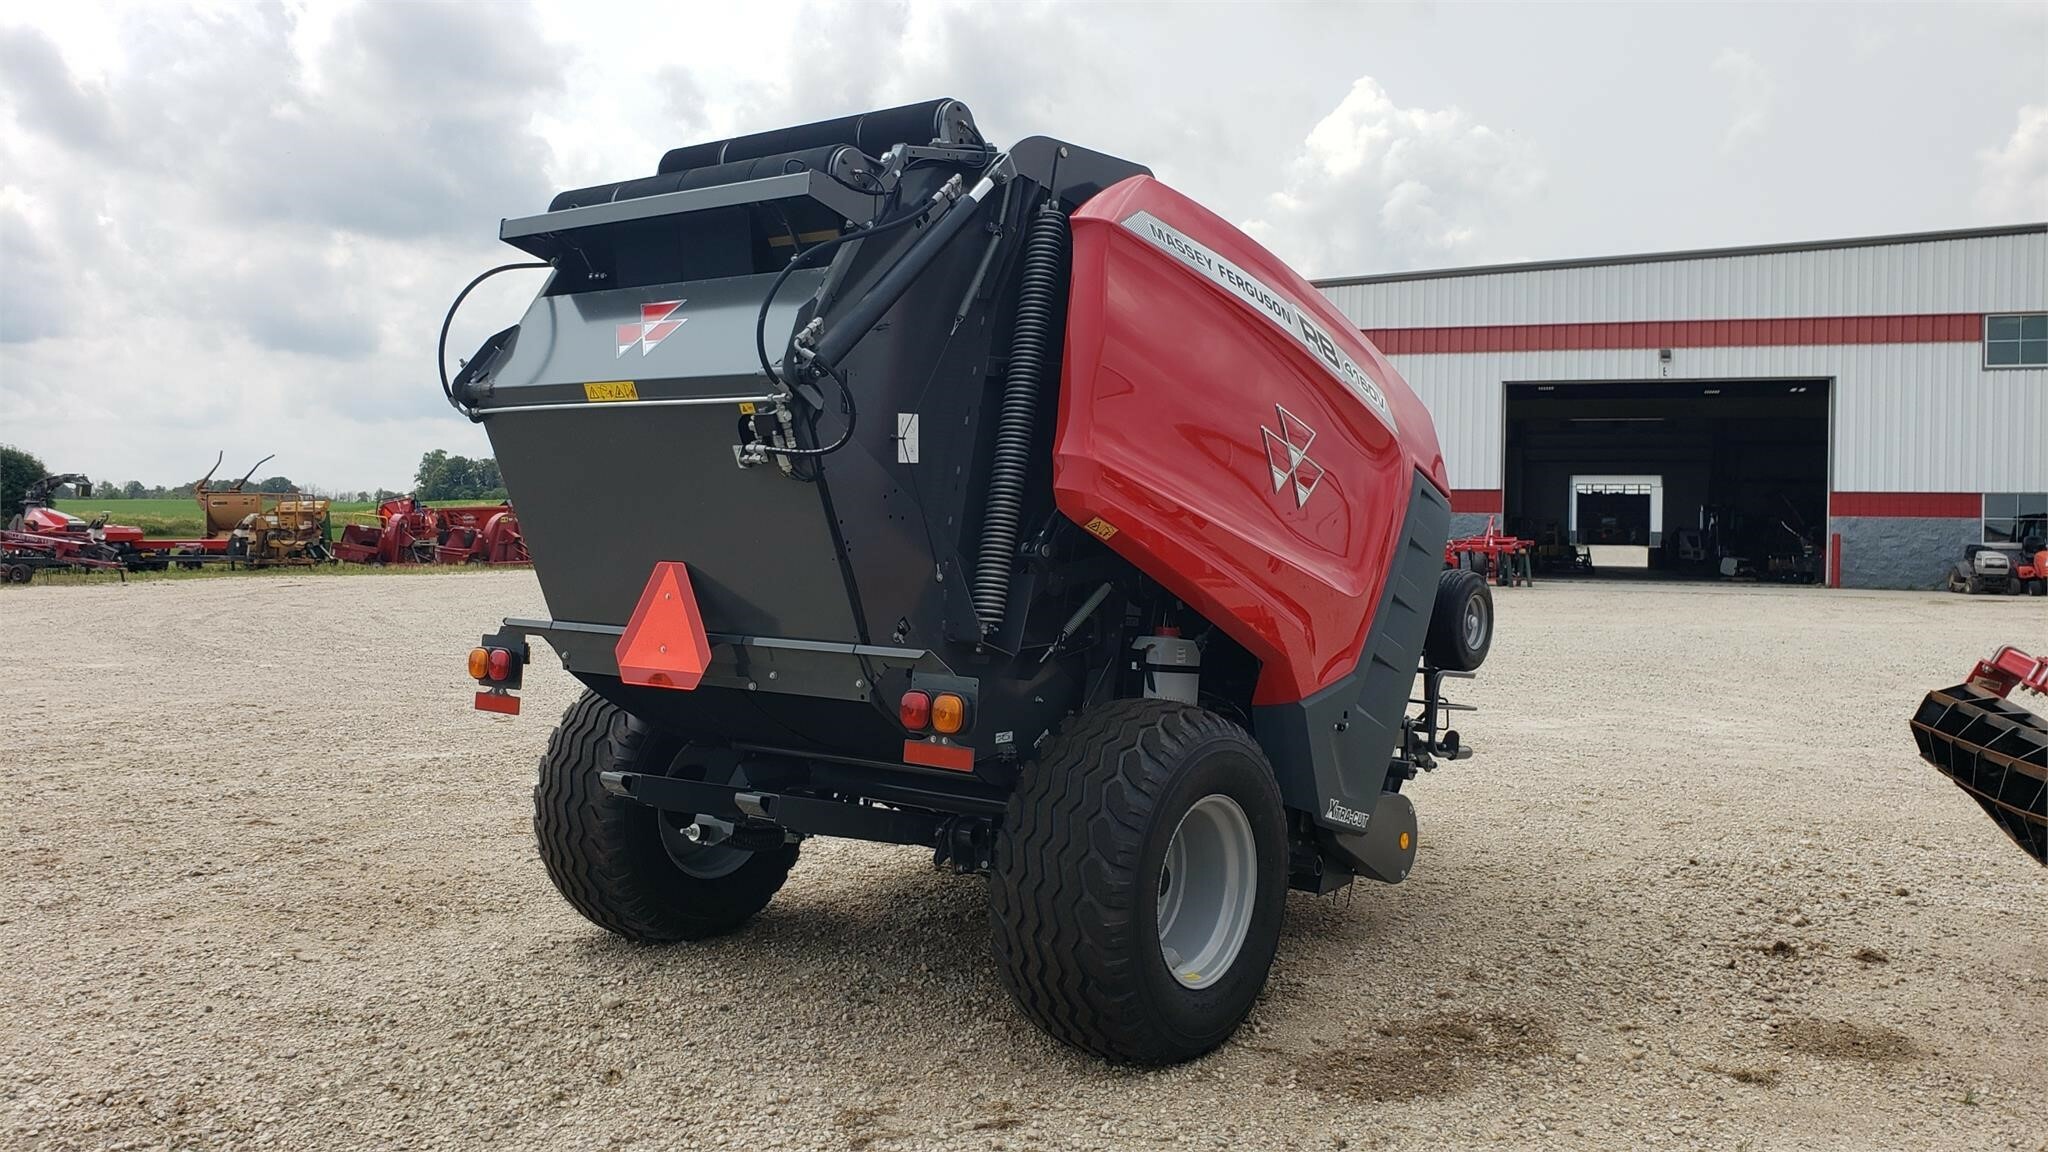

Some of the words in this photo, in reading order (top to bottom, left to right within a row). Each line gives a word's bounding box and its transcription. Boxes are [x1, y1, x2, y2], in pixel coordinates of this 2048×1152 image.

[1149, 223, 1213, 271] MASSEY
[1217, 263, 1292, 325] FERGUSON
[1297, 312, 1341, 370] RB
[1343, 361, 1385, 409] 4160V
